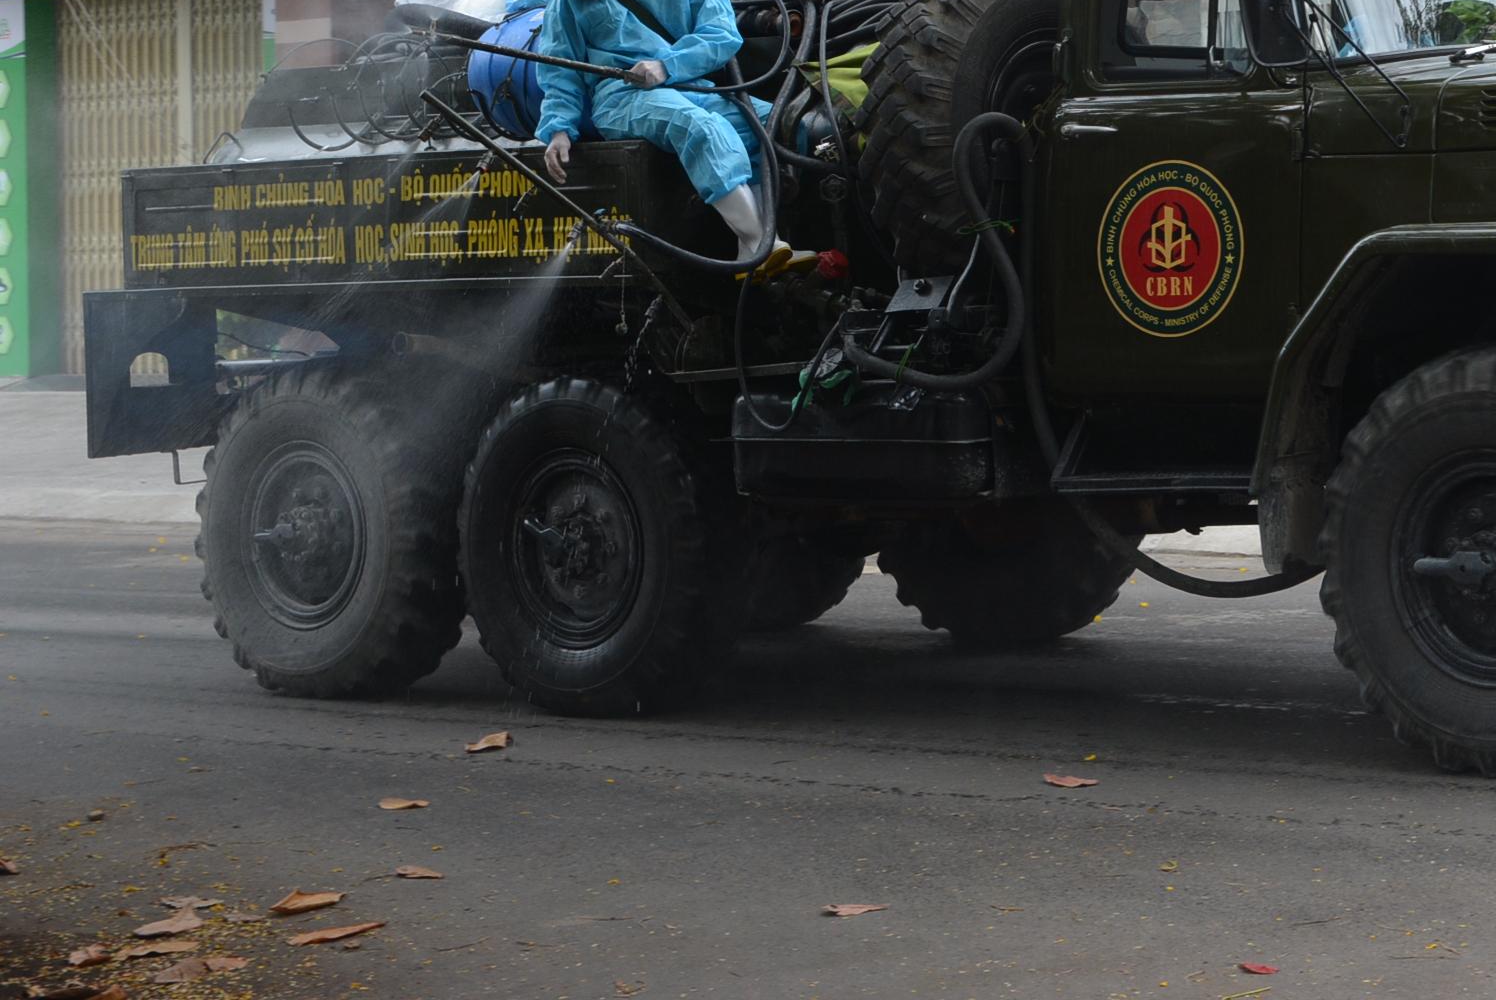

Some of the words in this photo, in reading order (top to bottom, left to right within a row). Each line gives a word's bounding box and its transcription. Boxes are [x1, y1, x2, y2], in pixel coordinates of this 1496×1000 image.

[213, 185, 252, 211] BINH
[255, 172, 310, 209] CHỦNG
[313, 173, 346, 207] HÓA
[352, 177, 385, 210] HỌC
[400, 168, 425, 206] BỘ
[429, 162, 473, 204] QUỐC
[130, 234, 174, 272] TRUNG
[177, 224, 206, 270] TÂM
[208, 223, 237, 268] ỨNG
[240, 220, 269, 268] PHÓ
[272, 223, 295, 273] SỰ
[295, 213, 315, 265] CỐ
[318, 217, 346, 266] HÓA
[390, 221, 426, 262] SINH
[467, 210, 520, 259] PHÓNG
[1106, 226, 1117, 254] BINH
[1108, 268, 1135, 311] CHEMICAL
[1133, 306, 1160, 326] CORPS
[1163, 310, 1200, 327] MINISTRY
[1198, 303, 1212, 316] OF
[1208, 267, 1233, 307] DEFENSE
[1145, 276, 1194, 297] CBRN
